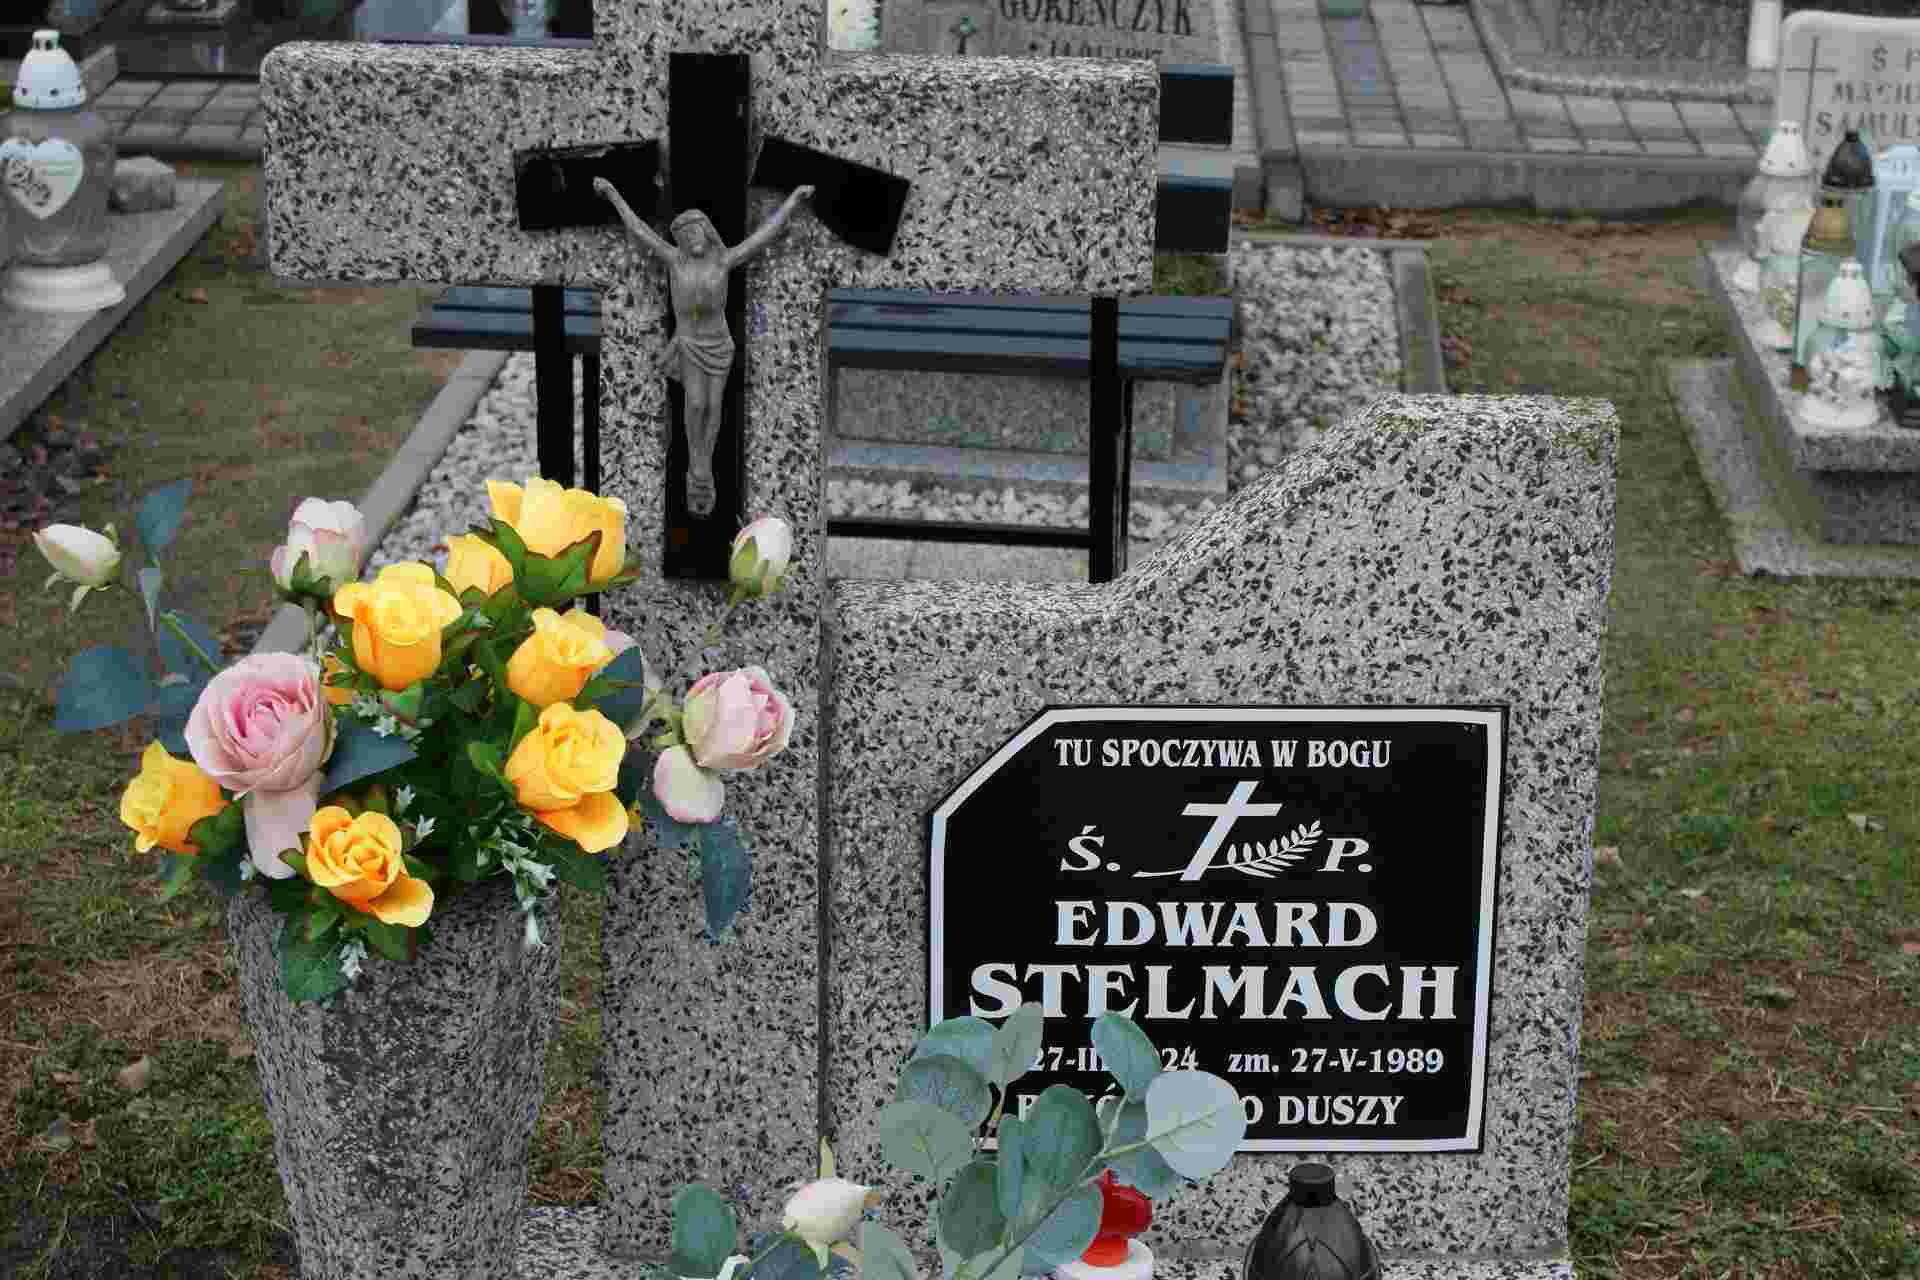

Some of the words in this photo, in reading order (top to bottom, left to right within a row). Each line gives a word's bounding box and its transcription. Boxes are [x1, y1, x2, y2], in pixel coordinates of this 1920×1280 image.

[1054, 739, 1093, 767] TU
[1102, 739, 1262, 768] SPOCZYWA
[1271, 740, 1299, 768] W
[1307, 740, 1392, 768] BOGU
[1060, 825, 1121, 873] Ś.
[1316, 837, 1373, 873] P.
[1054, 900, 1378, 947] EDWARD
[969, 962, 1459, 1021] STELMACH
[1227, 1053, 1280, 1073] zm.
[1291, 1047, 1444, 1073] 27-V-1989
[1277, 1095, 1405, 1125] DUSZY
